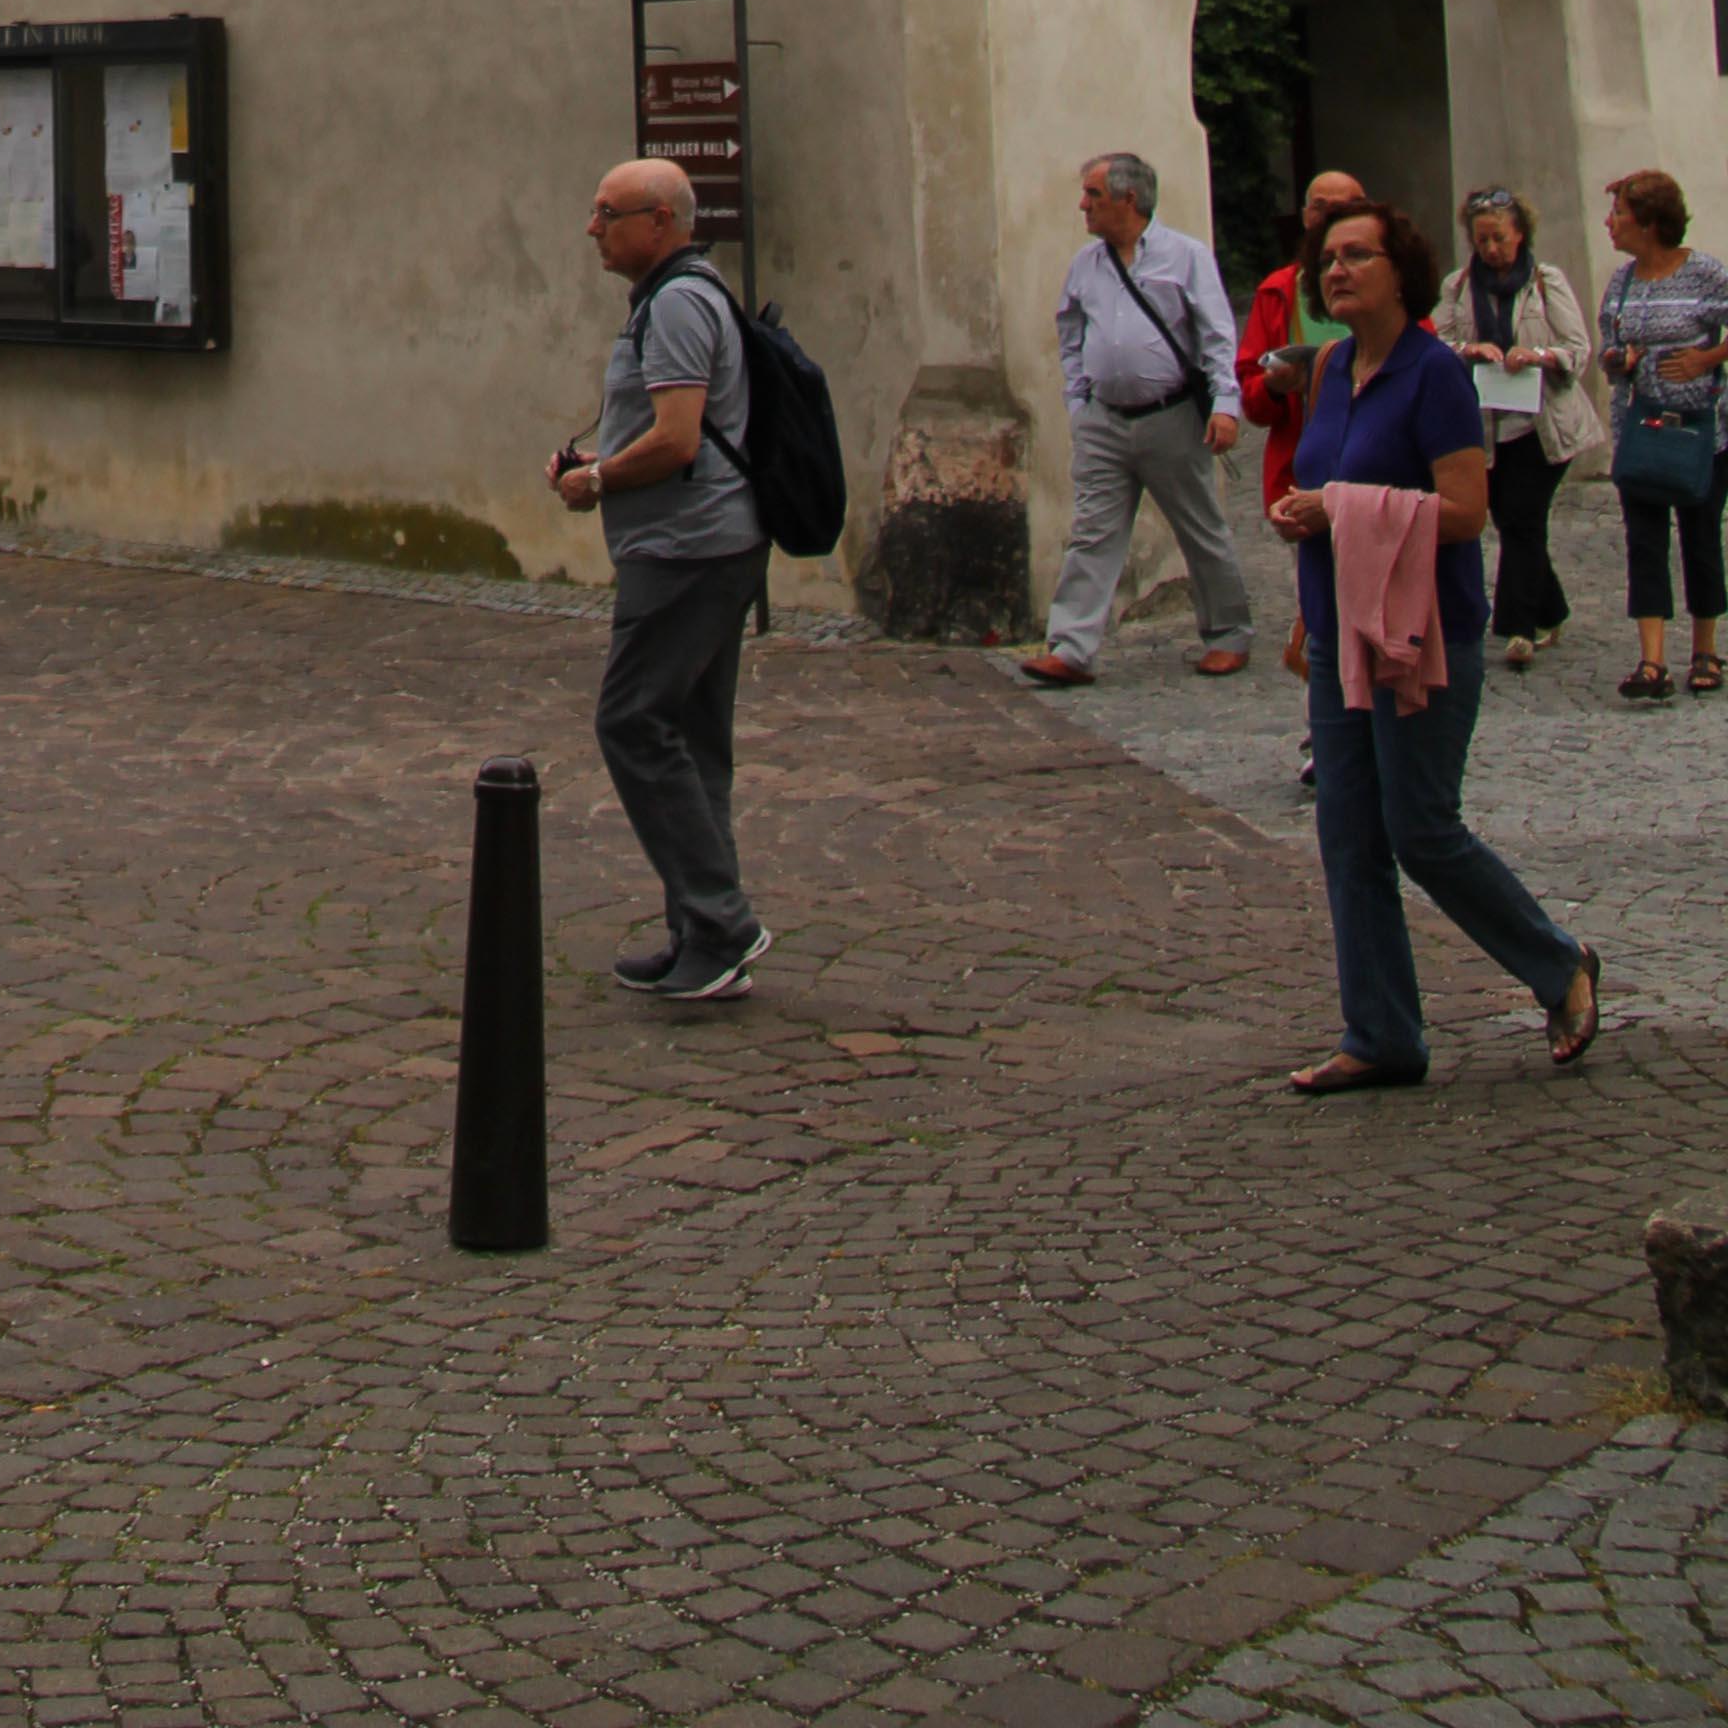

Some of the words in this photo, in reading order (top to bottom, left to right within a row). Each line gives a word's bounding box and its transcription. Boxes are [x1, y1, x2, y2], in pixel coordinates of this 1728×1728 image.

[23, 26, 44, 46] IN
[645, 143, 699, 157] SALZLAGER
[703, 142, 725, 156] HALL
